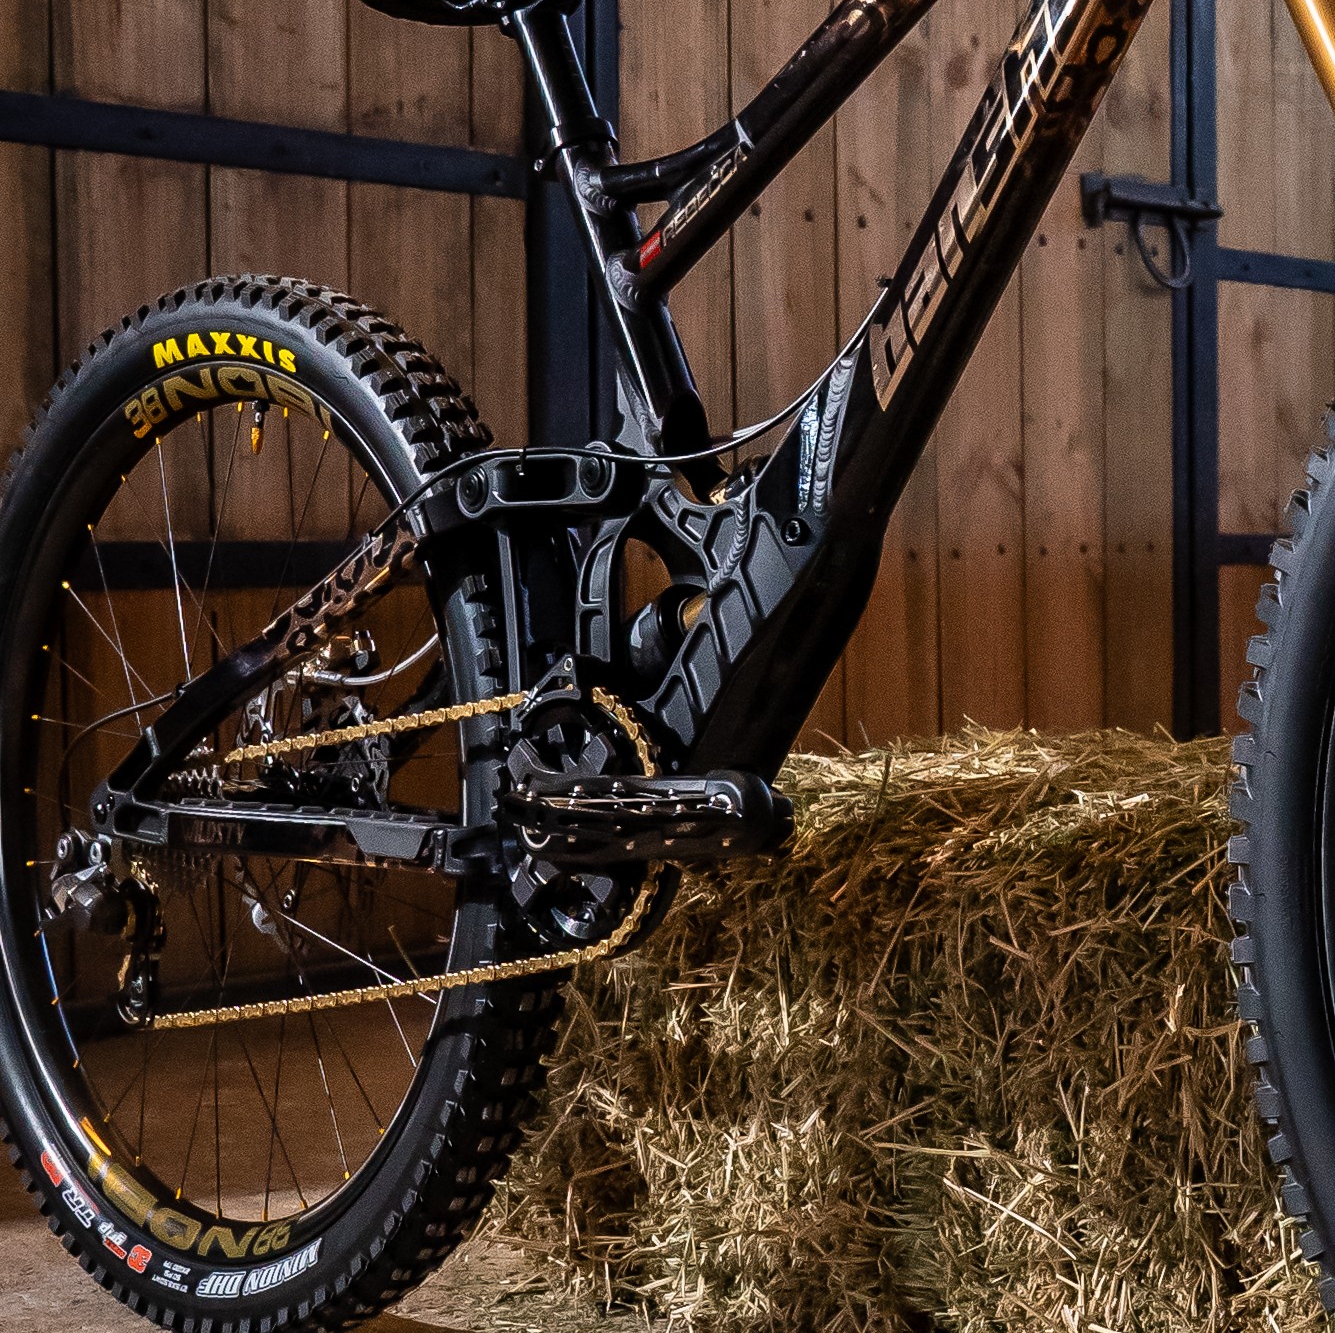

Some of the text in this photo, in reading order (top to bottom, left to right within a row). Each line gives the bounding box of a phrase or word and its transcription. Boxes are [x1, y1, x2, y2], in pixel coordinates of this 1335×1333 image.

[152, 331, 297, 374] MAXXIS
[123, 385, 168, 439] 38
[62, 1188, 96, 1229] TR
[196, 1237, 322, 1298] MINION DHF
